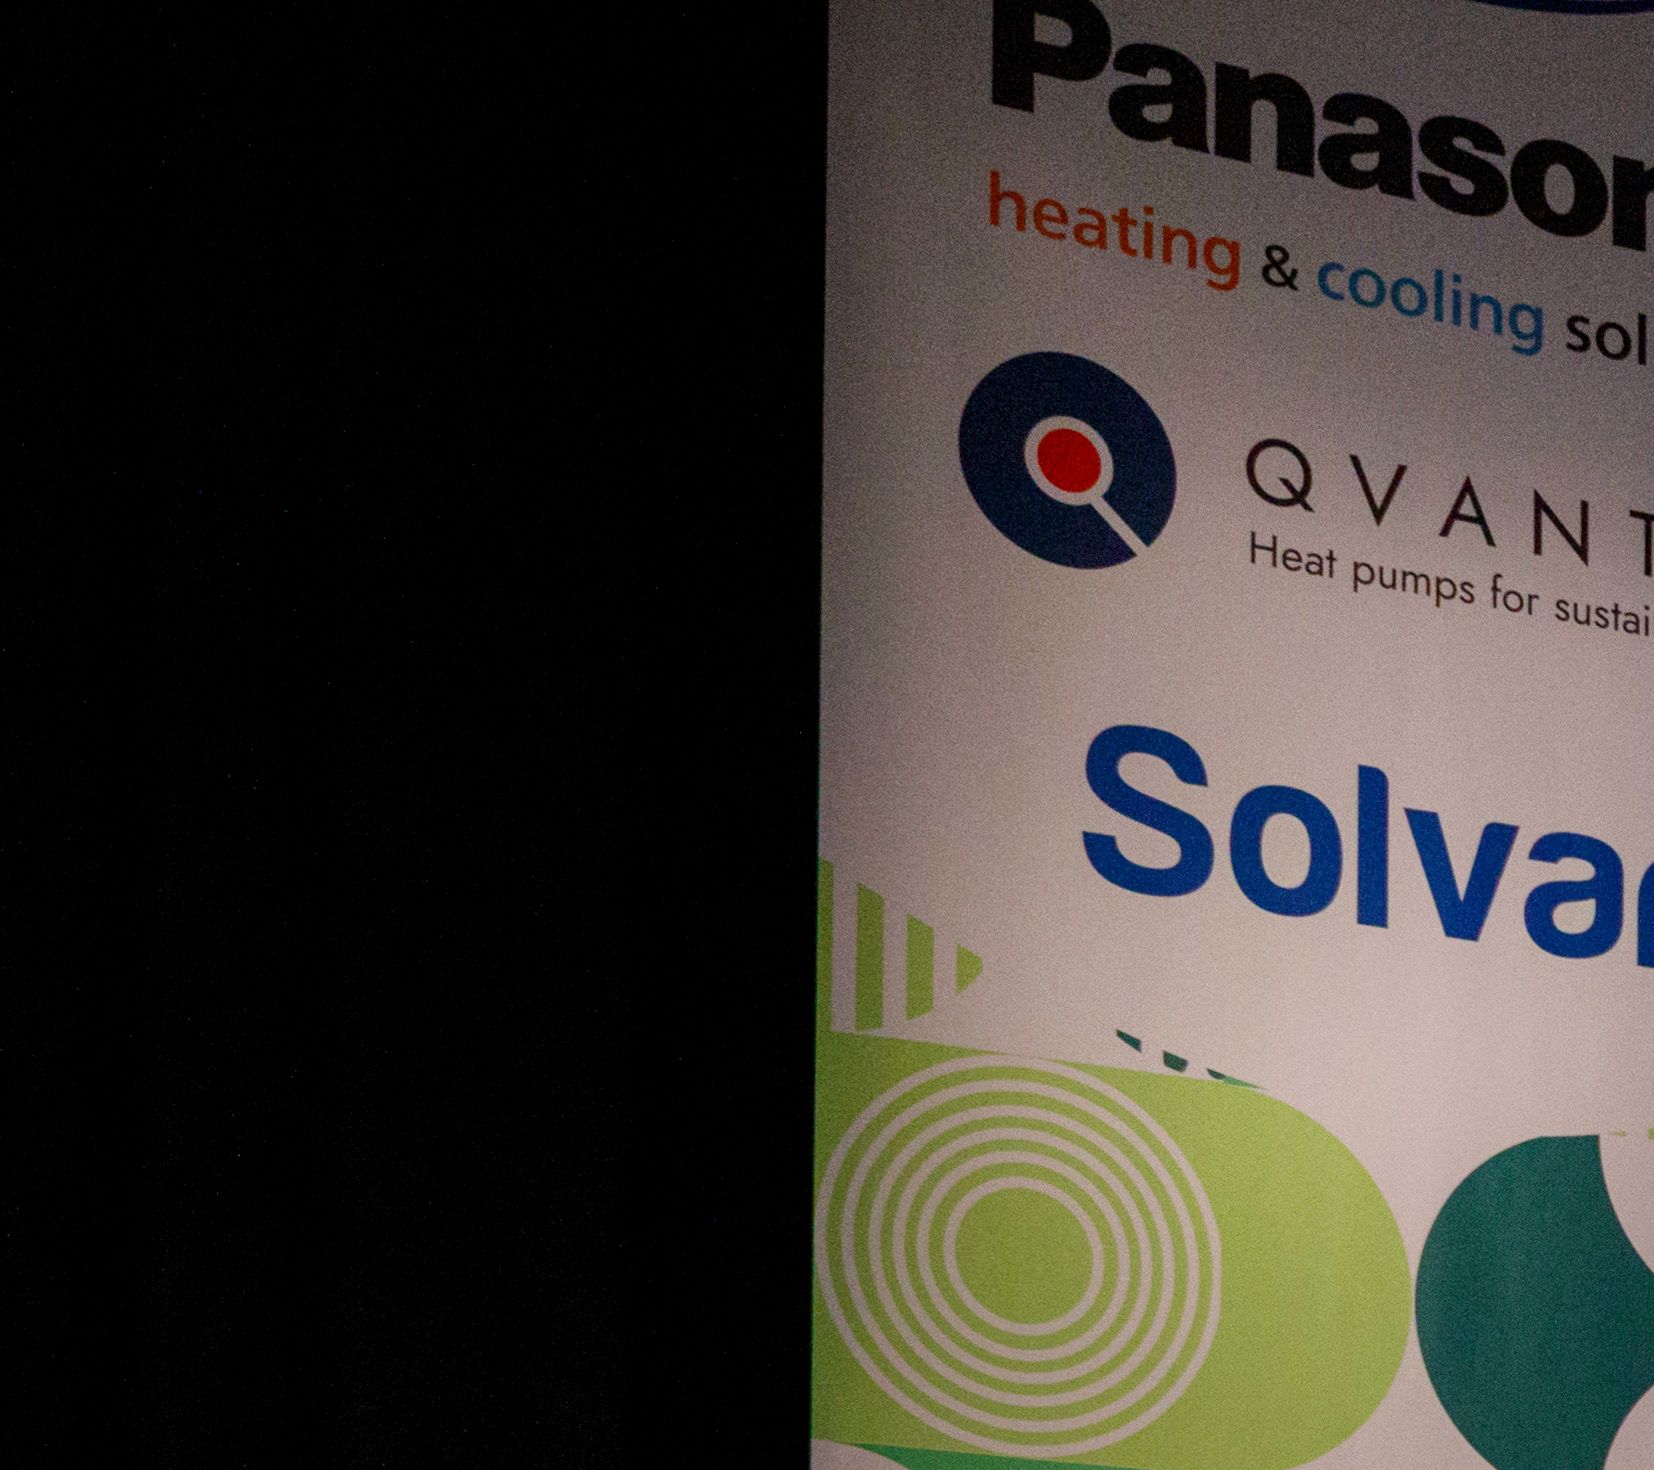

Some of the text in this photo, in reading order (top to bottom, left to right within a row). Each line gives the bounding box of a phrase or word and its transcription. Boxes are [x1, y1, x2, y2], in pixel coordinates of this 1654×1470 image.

[987, 170, 1243, 291] heating
[1260, 245, 1299, 289] &
[1316, 255, 1547, 357] cooling
[1249, 530, 1338, 580] Heat
[1351, 556, 1477, 610] pumps
[1490, 571, 1540, 617] for
